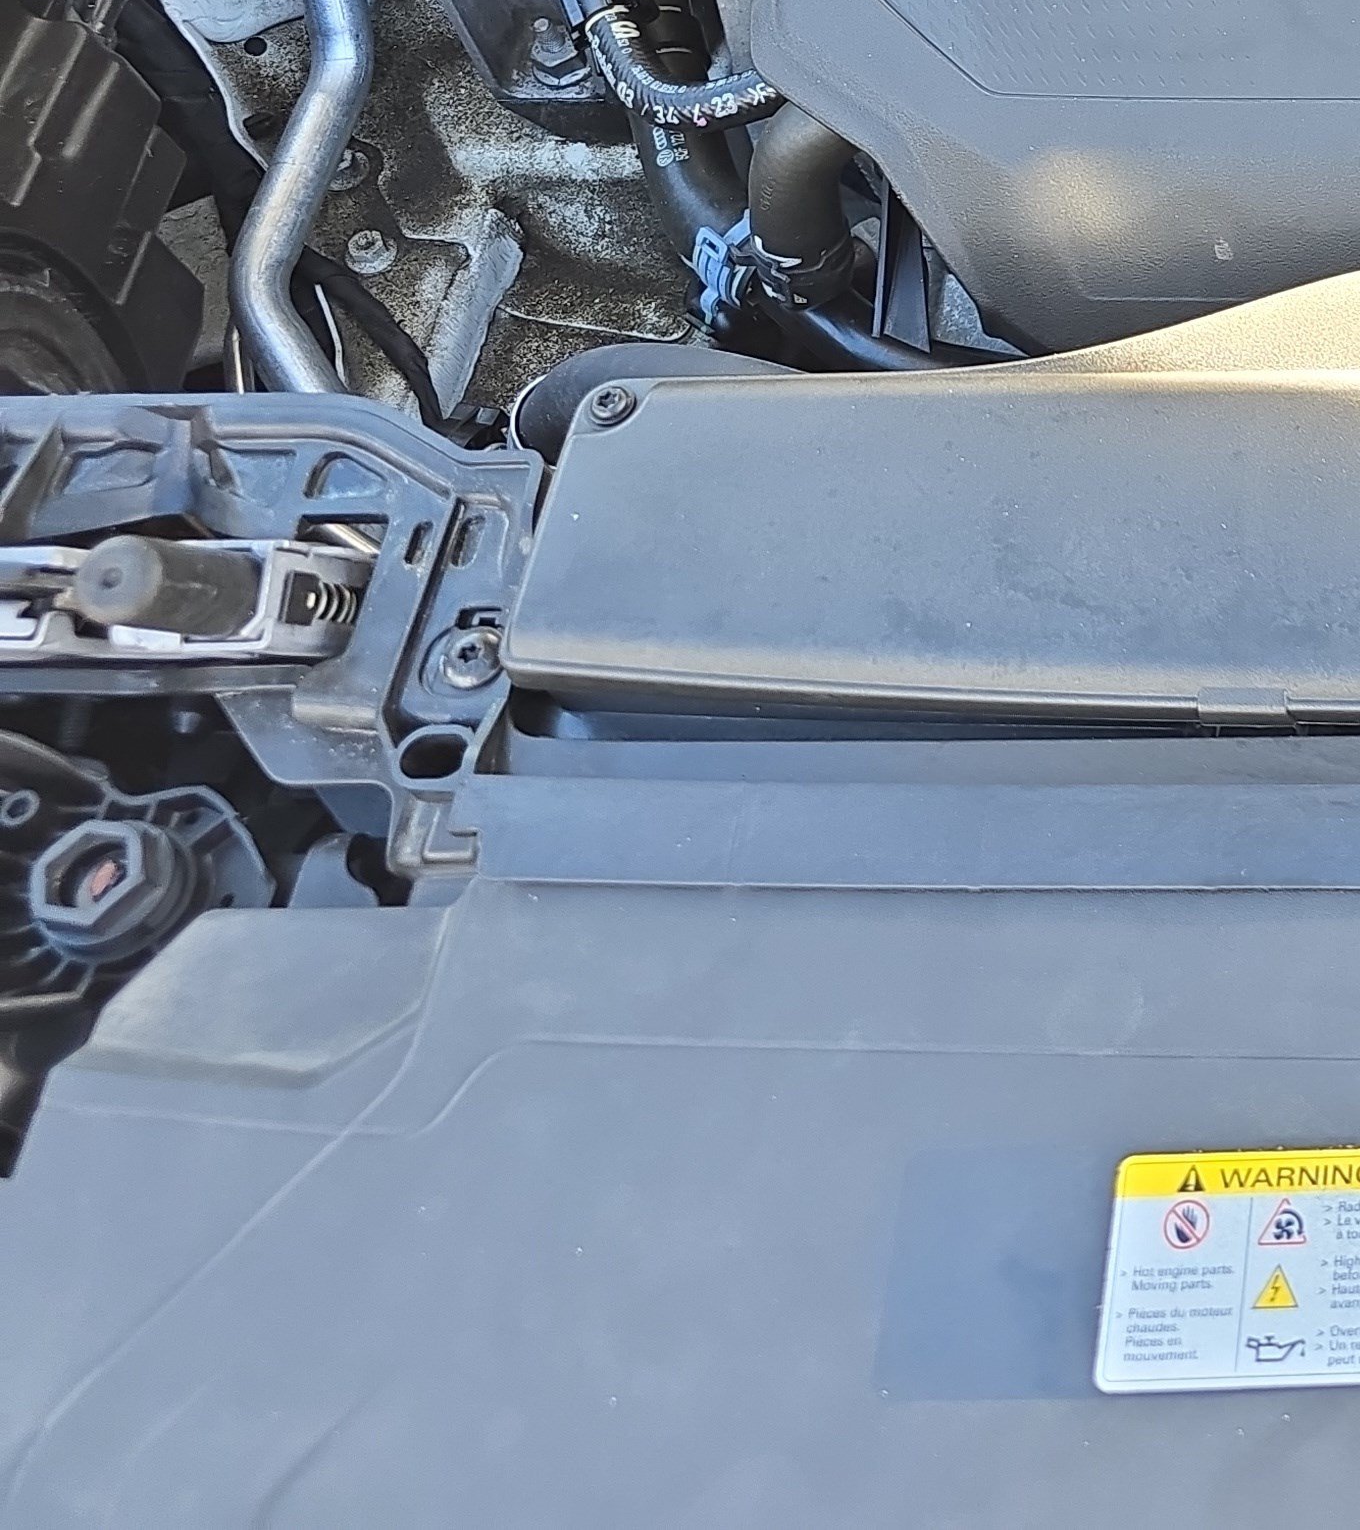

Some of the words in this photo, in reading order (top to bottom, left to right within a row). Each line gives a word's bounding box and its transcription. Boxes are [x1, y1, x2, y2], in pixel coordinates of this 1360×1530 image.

[1337, 1213, 1352, 1226] Le
[1132, 1266, 1156, 1277] Hot
[1157, 1266, 1199, 1278] engine
[1131, 1279, 1177, 1292] Moving
[1170, 1307, 1186, 1318] du
[1189, 1306, 1233, 1318] moteur
[1166, 1337, 1182, 1346] en
[1328, 1339, 1347, 1351] Un
[1327, 1352, 1355, 1367] peut
